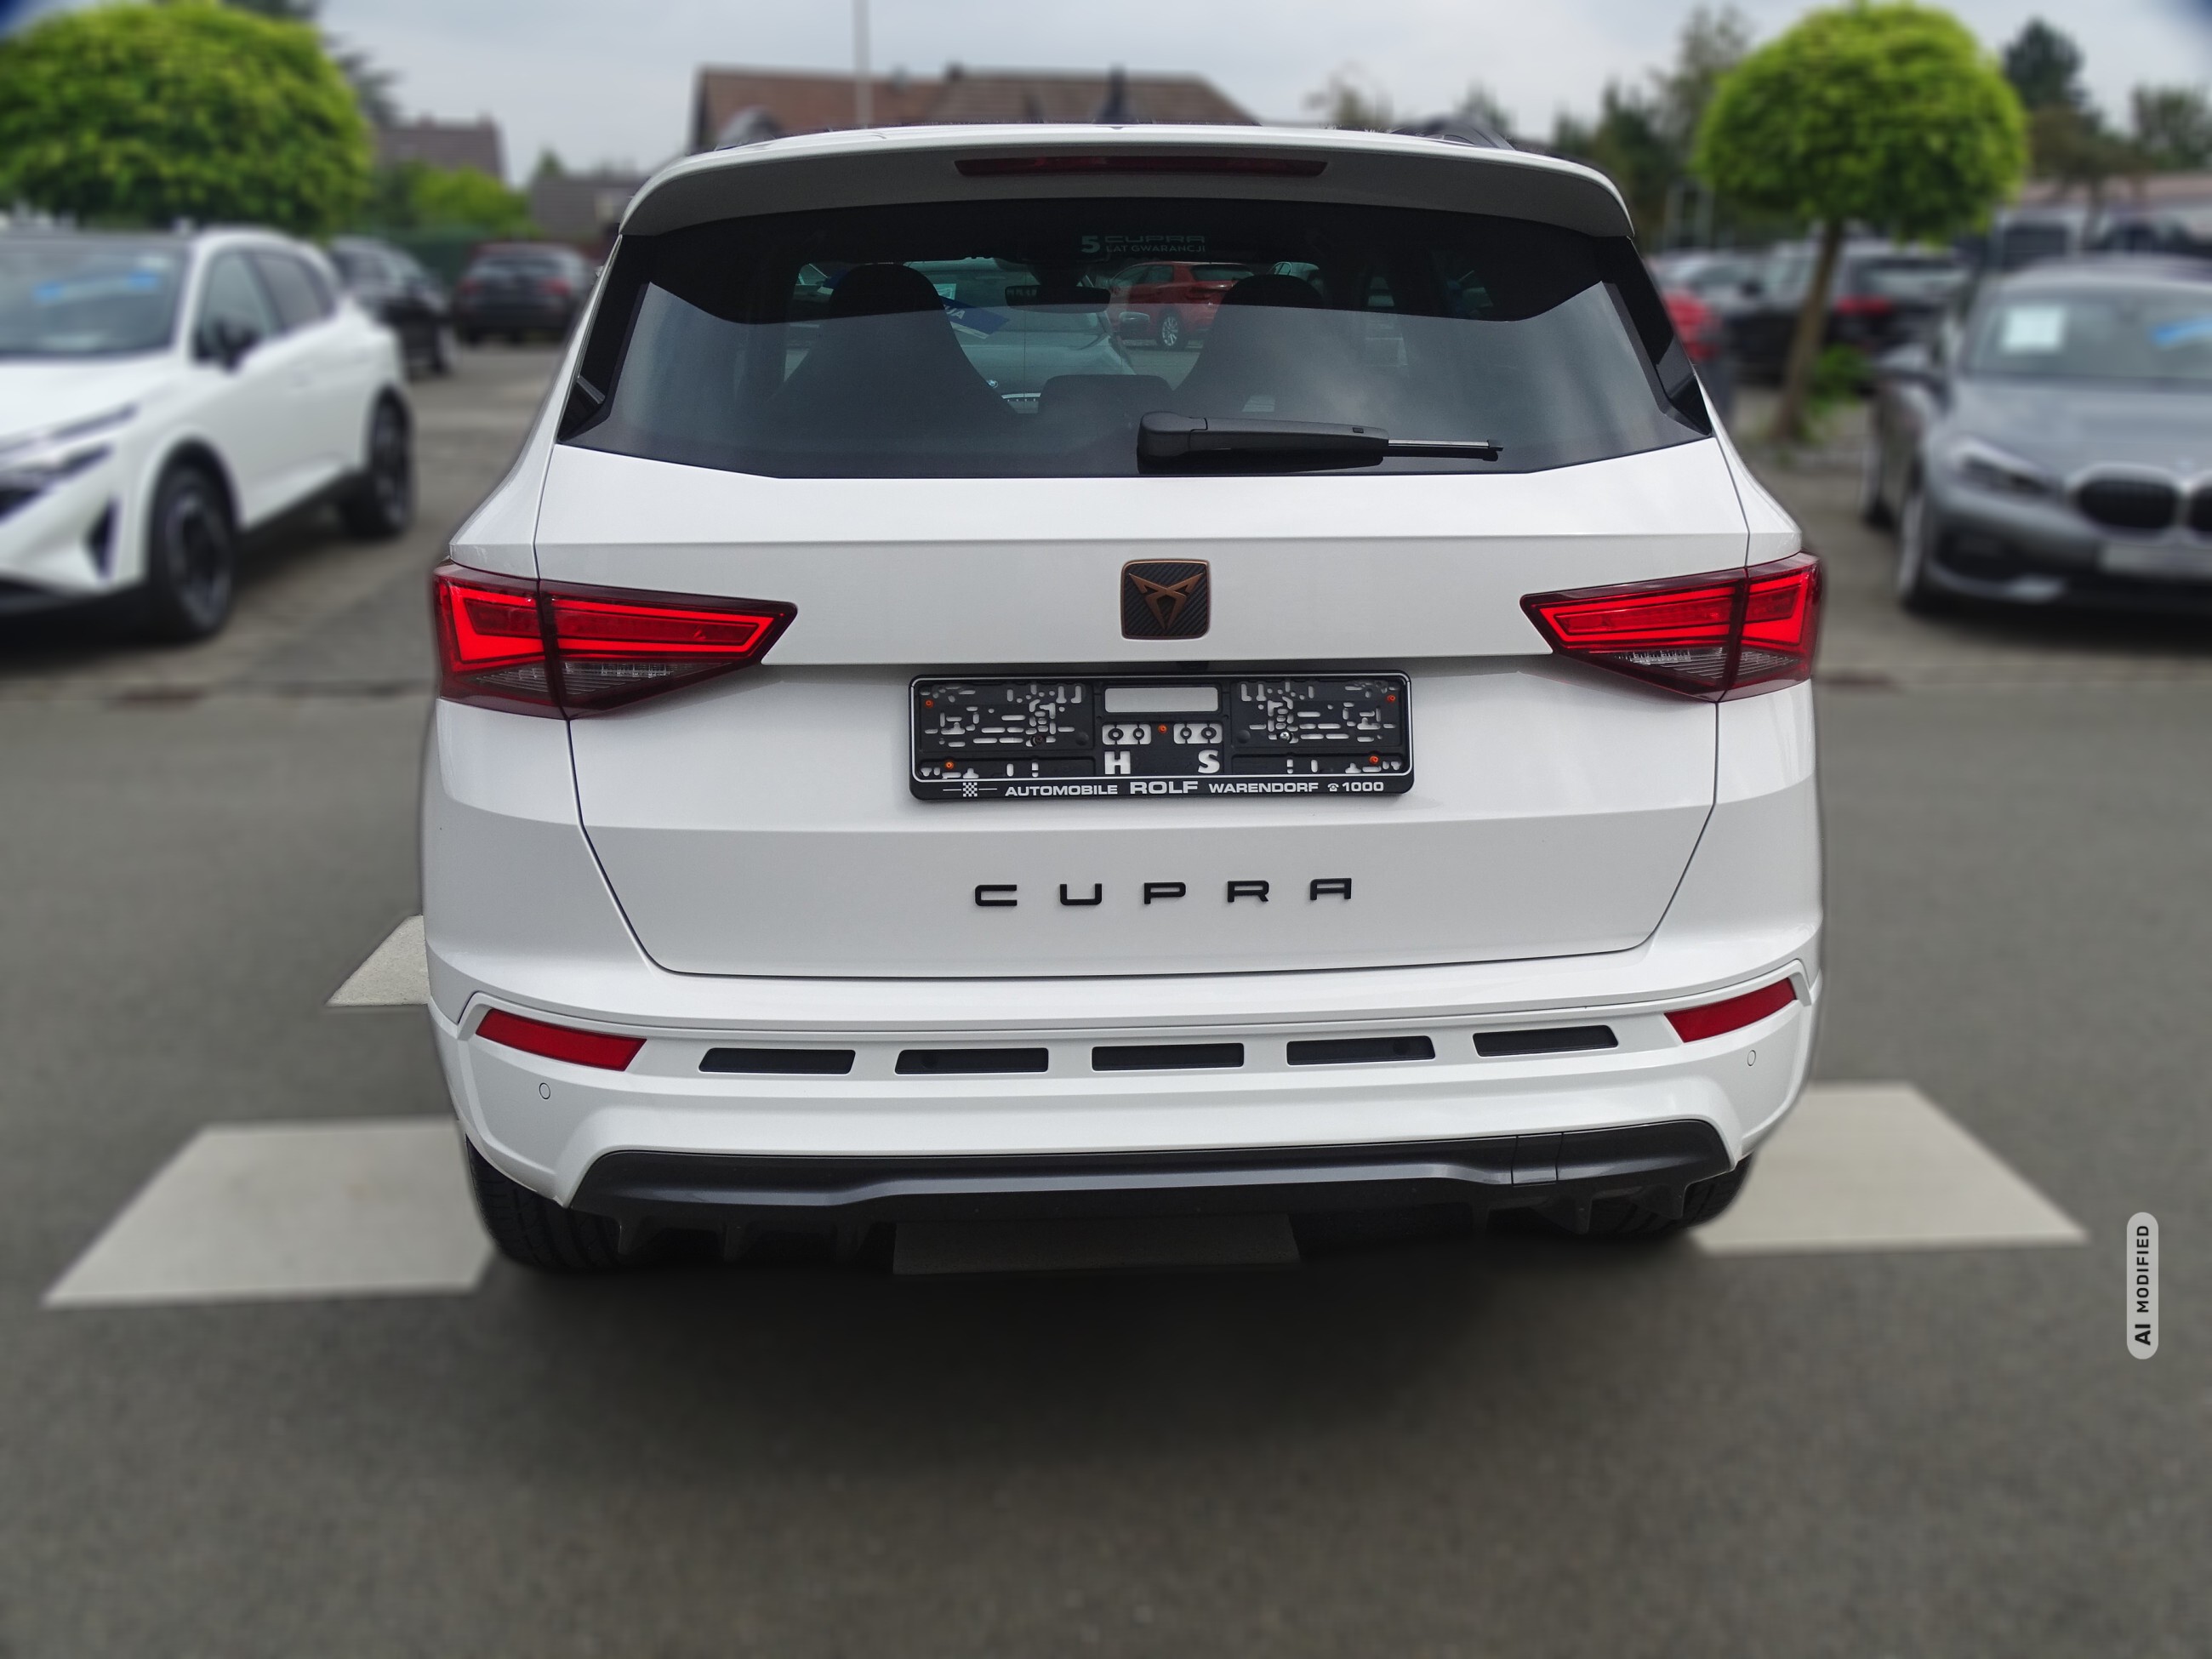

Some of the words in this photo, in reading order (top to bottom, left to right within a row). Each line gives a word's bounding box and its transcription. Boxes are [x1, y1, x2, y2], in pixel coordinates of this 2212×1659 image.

[1081, 236, 1100, 253] 5
[1005, 784, 1118, 796] AUTOMOBILE
[1130, 781, 1198, 795] ROLF
[1208, 783, 1319, 793] WARENDORF
[1343, 782, 1383, 792] 1000
[975, 878, 1352, 906] CUPRA
